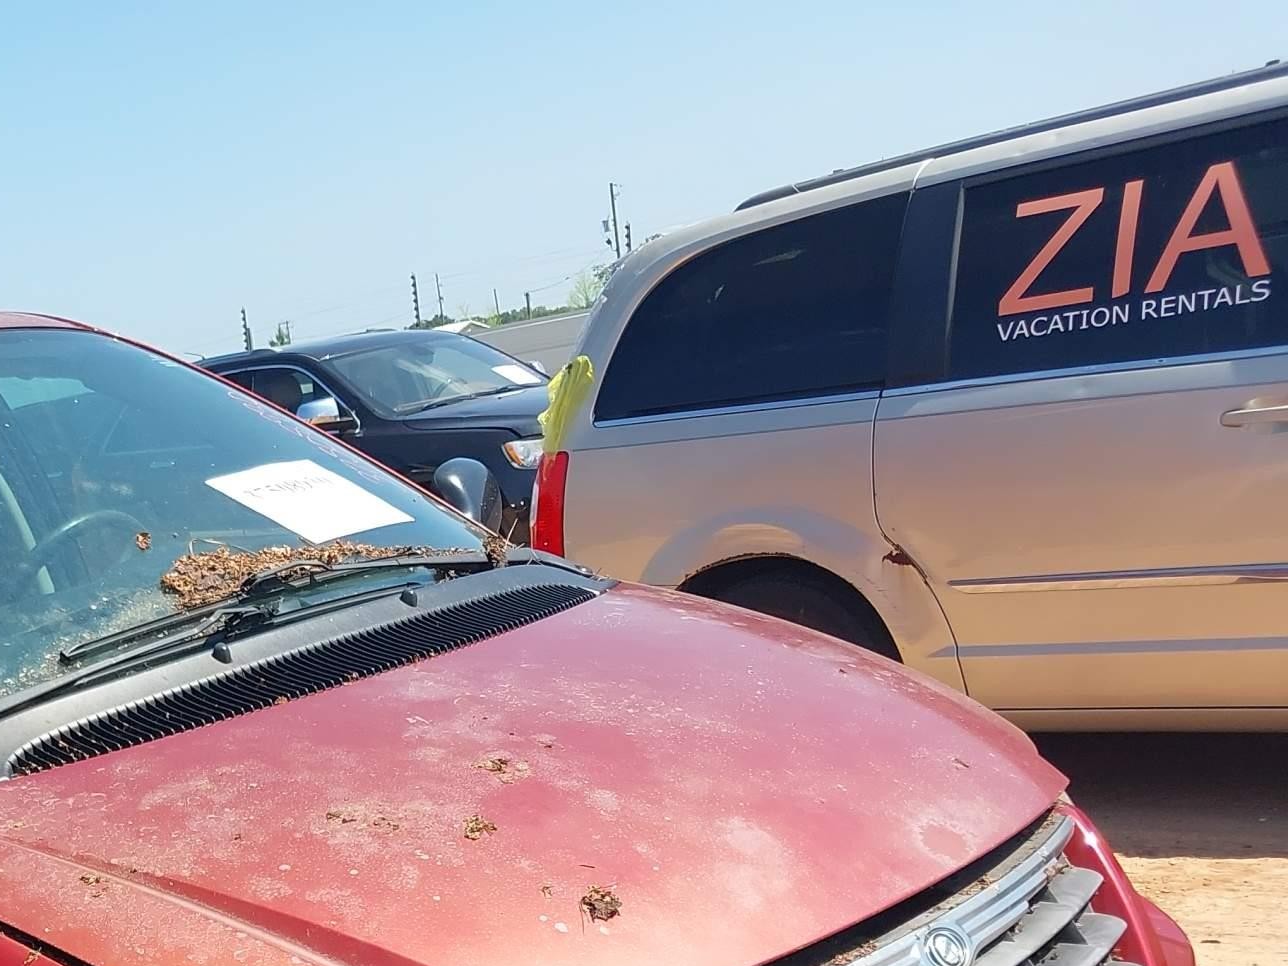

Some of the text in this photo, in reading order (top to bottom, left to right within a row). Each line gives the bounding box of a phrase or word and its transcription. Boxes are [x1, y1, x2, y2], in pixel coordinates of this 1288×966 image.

[998, 161, 1271, 316] ZIA
[997, 280, 1272, 341] VACATION RENTALS
